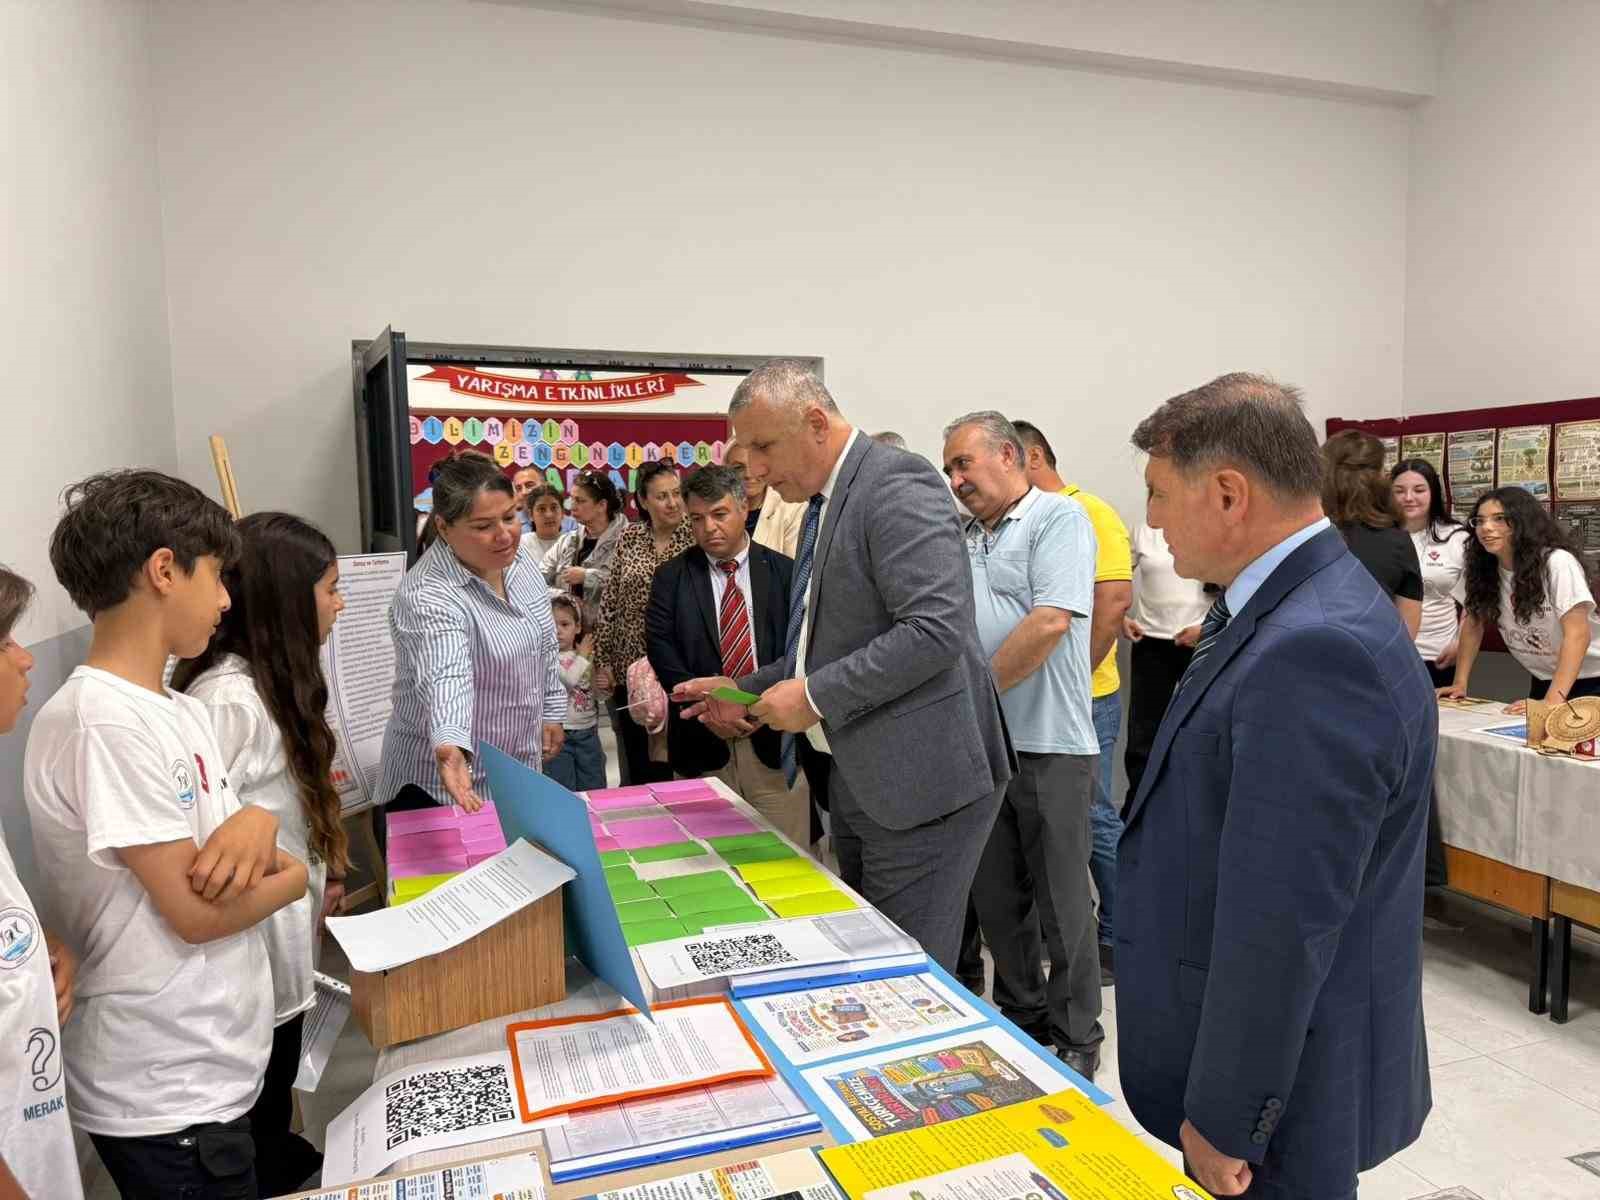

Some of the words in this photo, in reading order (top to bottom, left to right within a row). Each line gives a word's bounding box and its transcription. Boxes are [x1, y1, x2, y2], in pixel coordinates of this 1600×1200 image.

[457, 374, 540, 399] YARIŞMA
[545, 376, 665, 401] ETKİNLİKLERİ
[23, 1095, 65, 1121] MERAK
